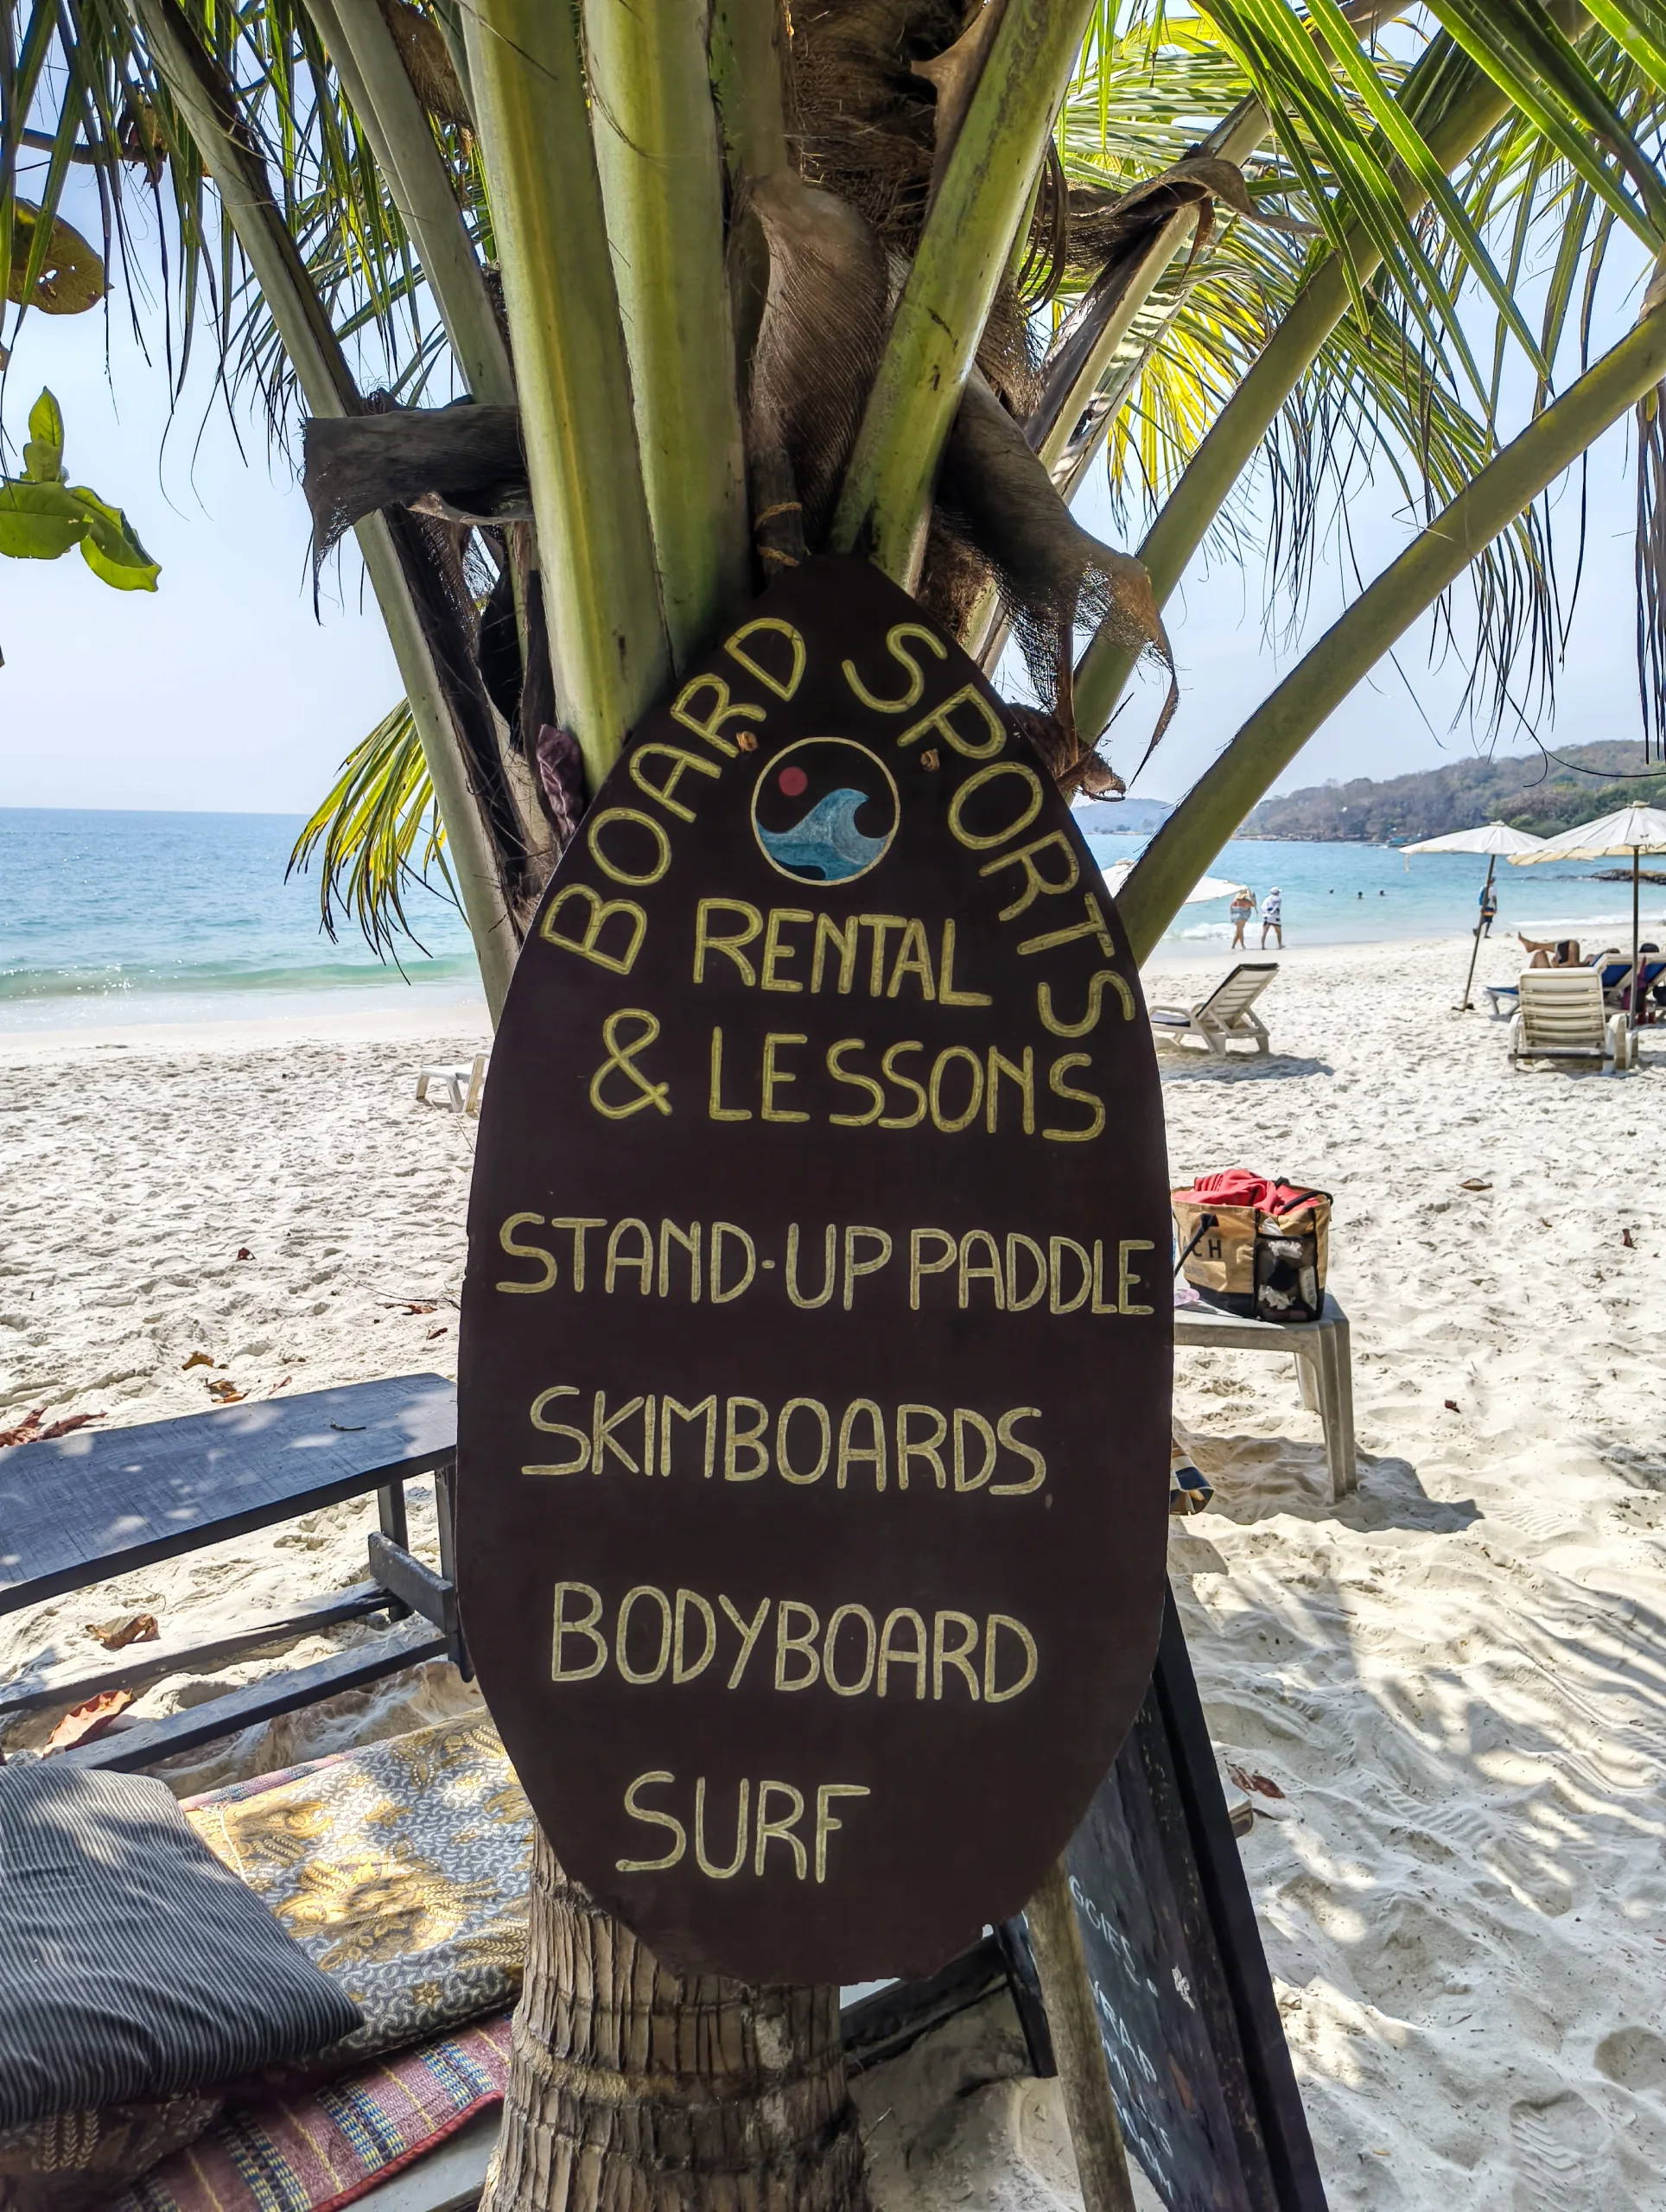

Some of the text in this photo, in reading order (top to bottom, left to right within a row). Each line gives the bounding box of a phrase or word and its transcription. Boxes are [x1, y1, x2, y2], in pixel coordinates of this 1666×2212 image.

[541, 618, 1134, 1038] BOARD SPORTS
[693, 898, 991, 1007] RENTAL
[589, 1007, 1105, 1141] & LESSONS
[495, 1211, 1155, 1315] STAND-UP PADDLE
[521, 1385, 1046, 1496] SKIMBOARDS
[551, 1581, 1038, 1703] BODYBOARD
[615, 1770, 871, 1884] SURF
